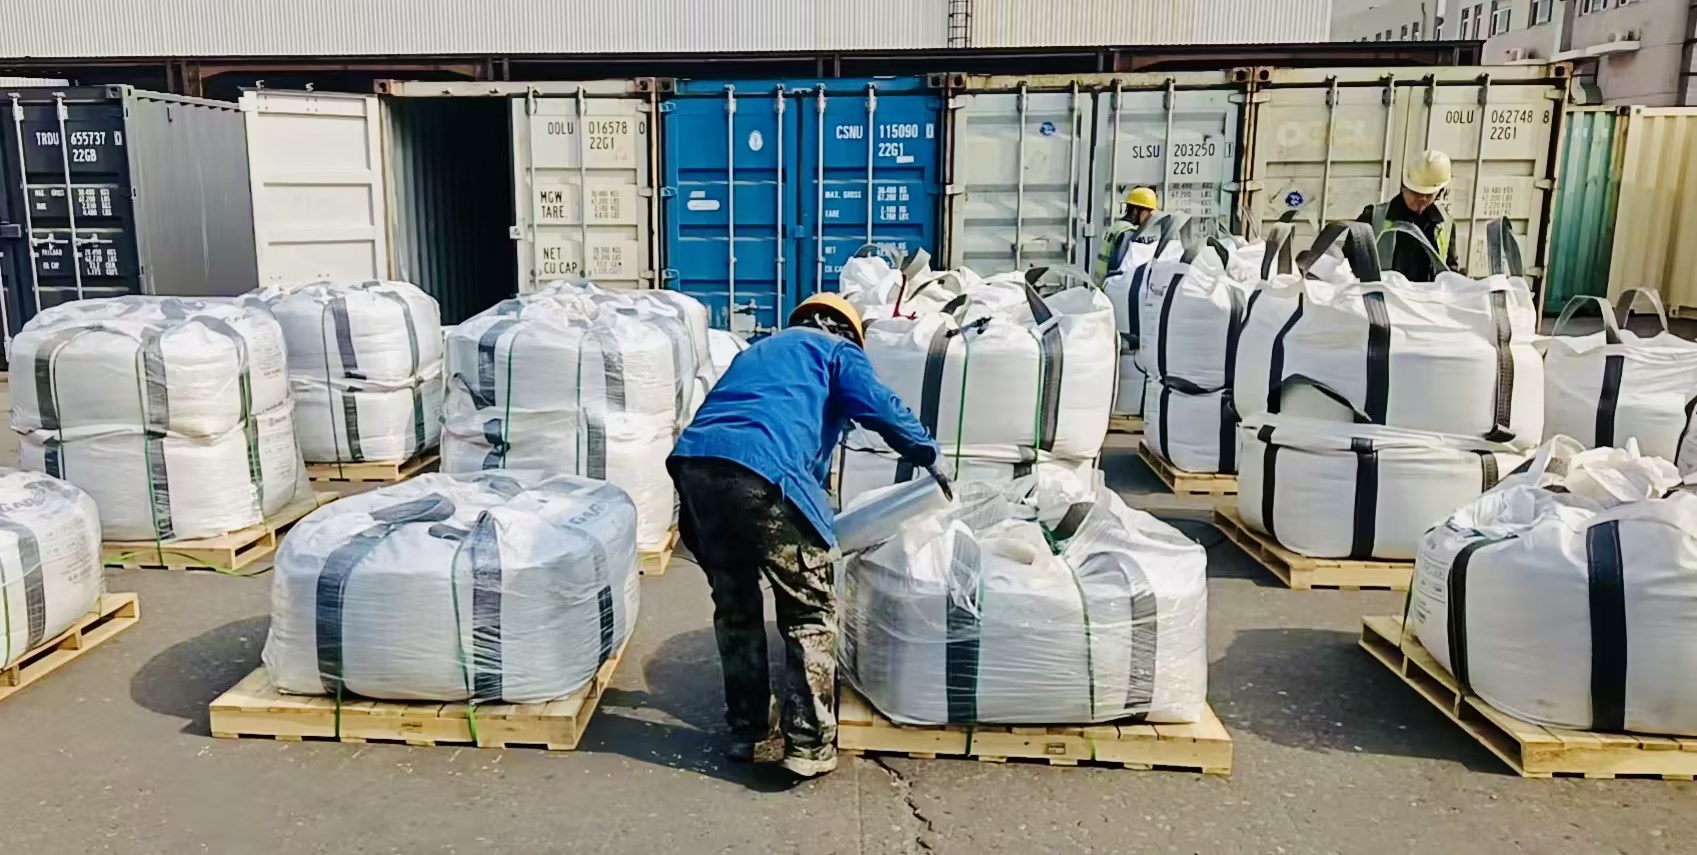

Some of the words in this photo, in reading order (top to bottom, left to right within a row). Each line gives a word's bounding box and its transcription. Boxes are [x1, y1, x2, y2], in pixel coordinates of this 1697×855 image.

[1491, 109, 1533, 124] 062748
[1542, 109, 1550, 124] 8
[588, 120, 628, 134] 016578
[836, 125, 863, 139] CSNU
[879, 123, 918, 139] 115090
[1490, 125, 1517, 140] 22G1
[35, 131, 60, 146] TRDU
[70, 131, 106, 146] 655737
[590, 136, 615, 150] 22G1
[72, 149, 97, 162] 22GB
[878, 142, 904, 157] 22G1
[1132, 145, 1160, 158] SLSU
[1174, 143, 1215, 157] 203250
[1173, 161, 1200, 175] 22G1
[543, 247, 561, 260] NET
